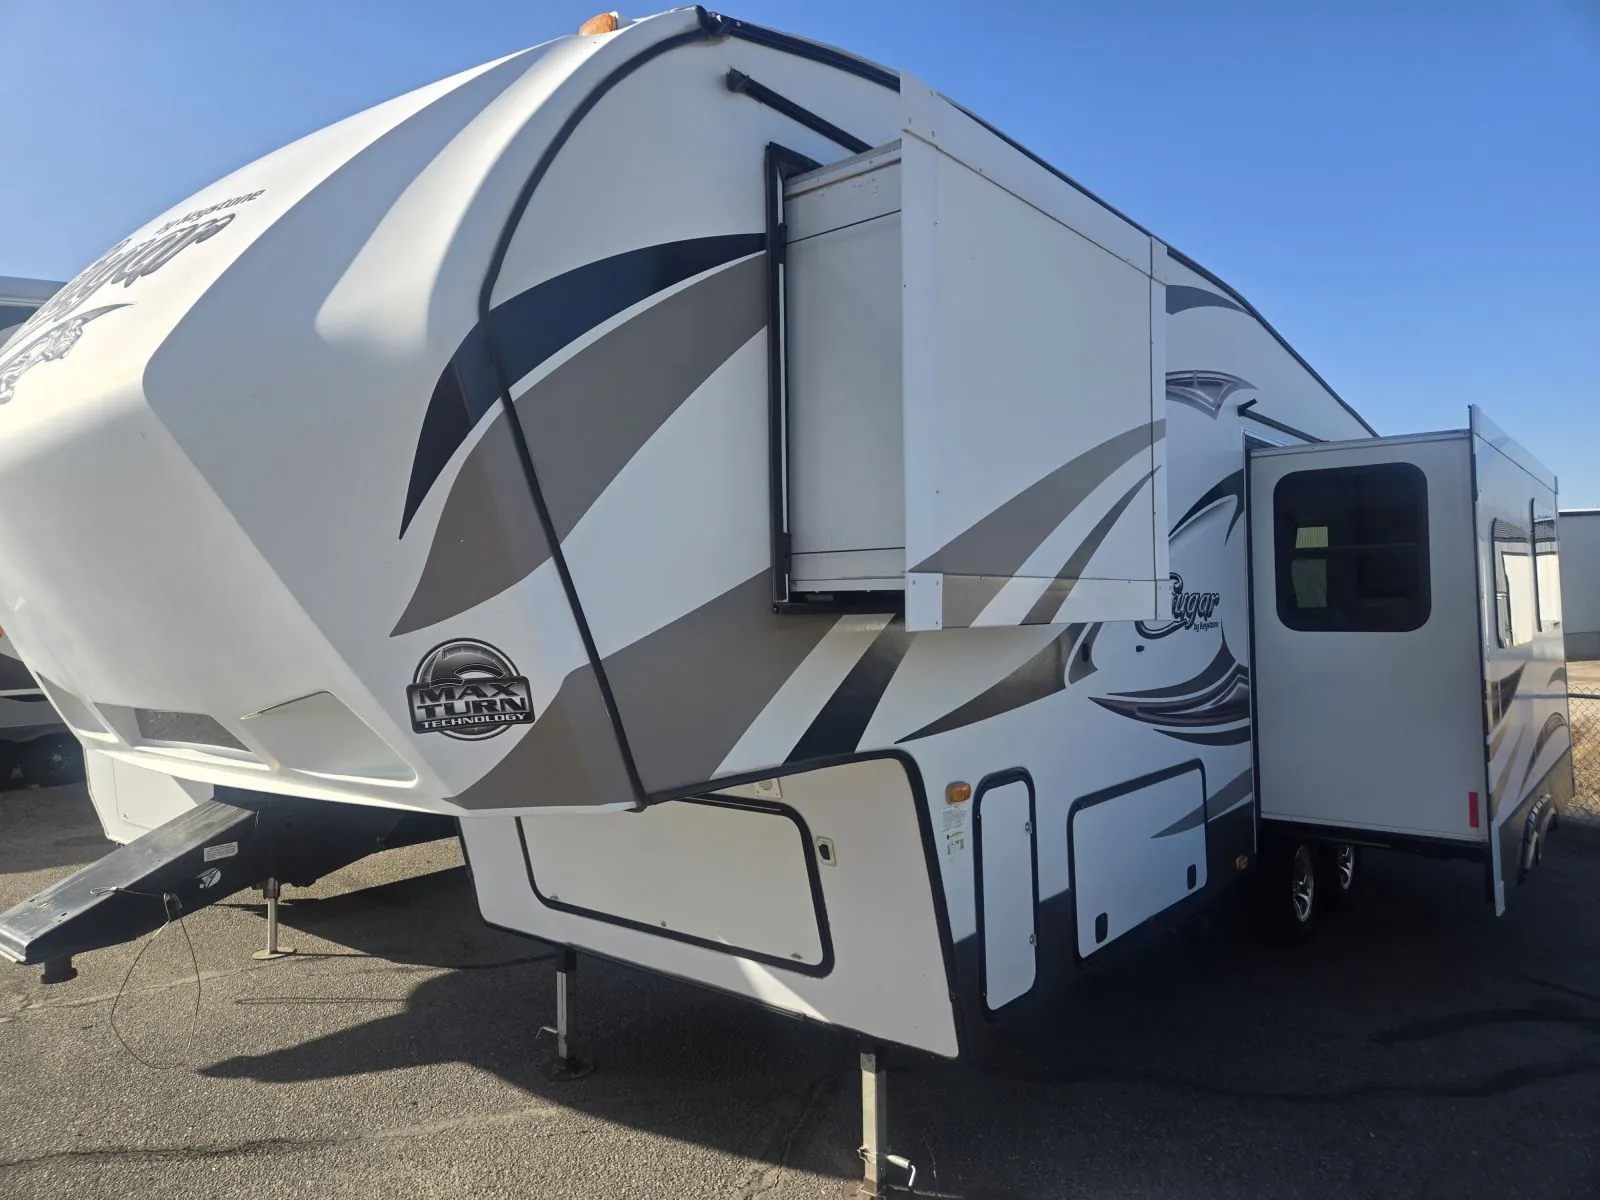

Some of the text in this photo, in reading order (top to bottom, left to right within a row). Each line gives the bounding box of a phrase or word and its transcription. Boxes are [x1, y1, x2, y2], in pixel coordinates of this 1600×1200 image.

[419, 682, 521, 703] MAX
[417, 697, 527, 719] TURN
[422, 713, 526, 729] TECHNOLOGY
